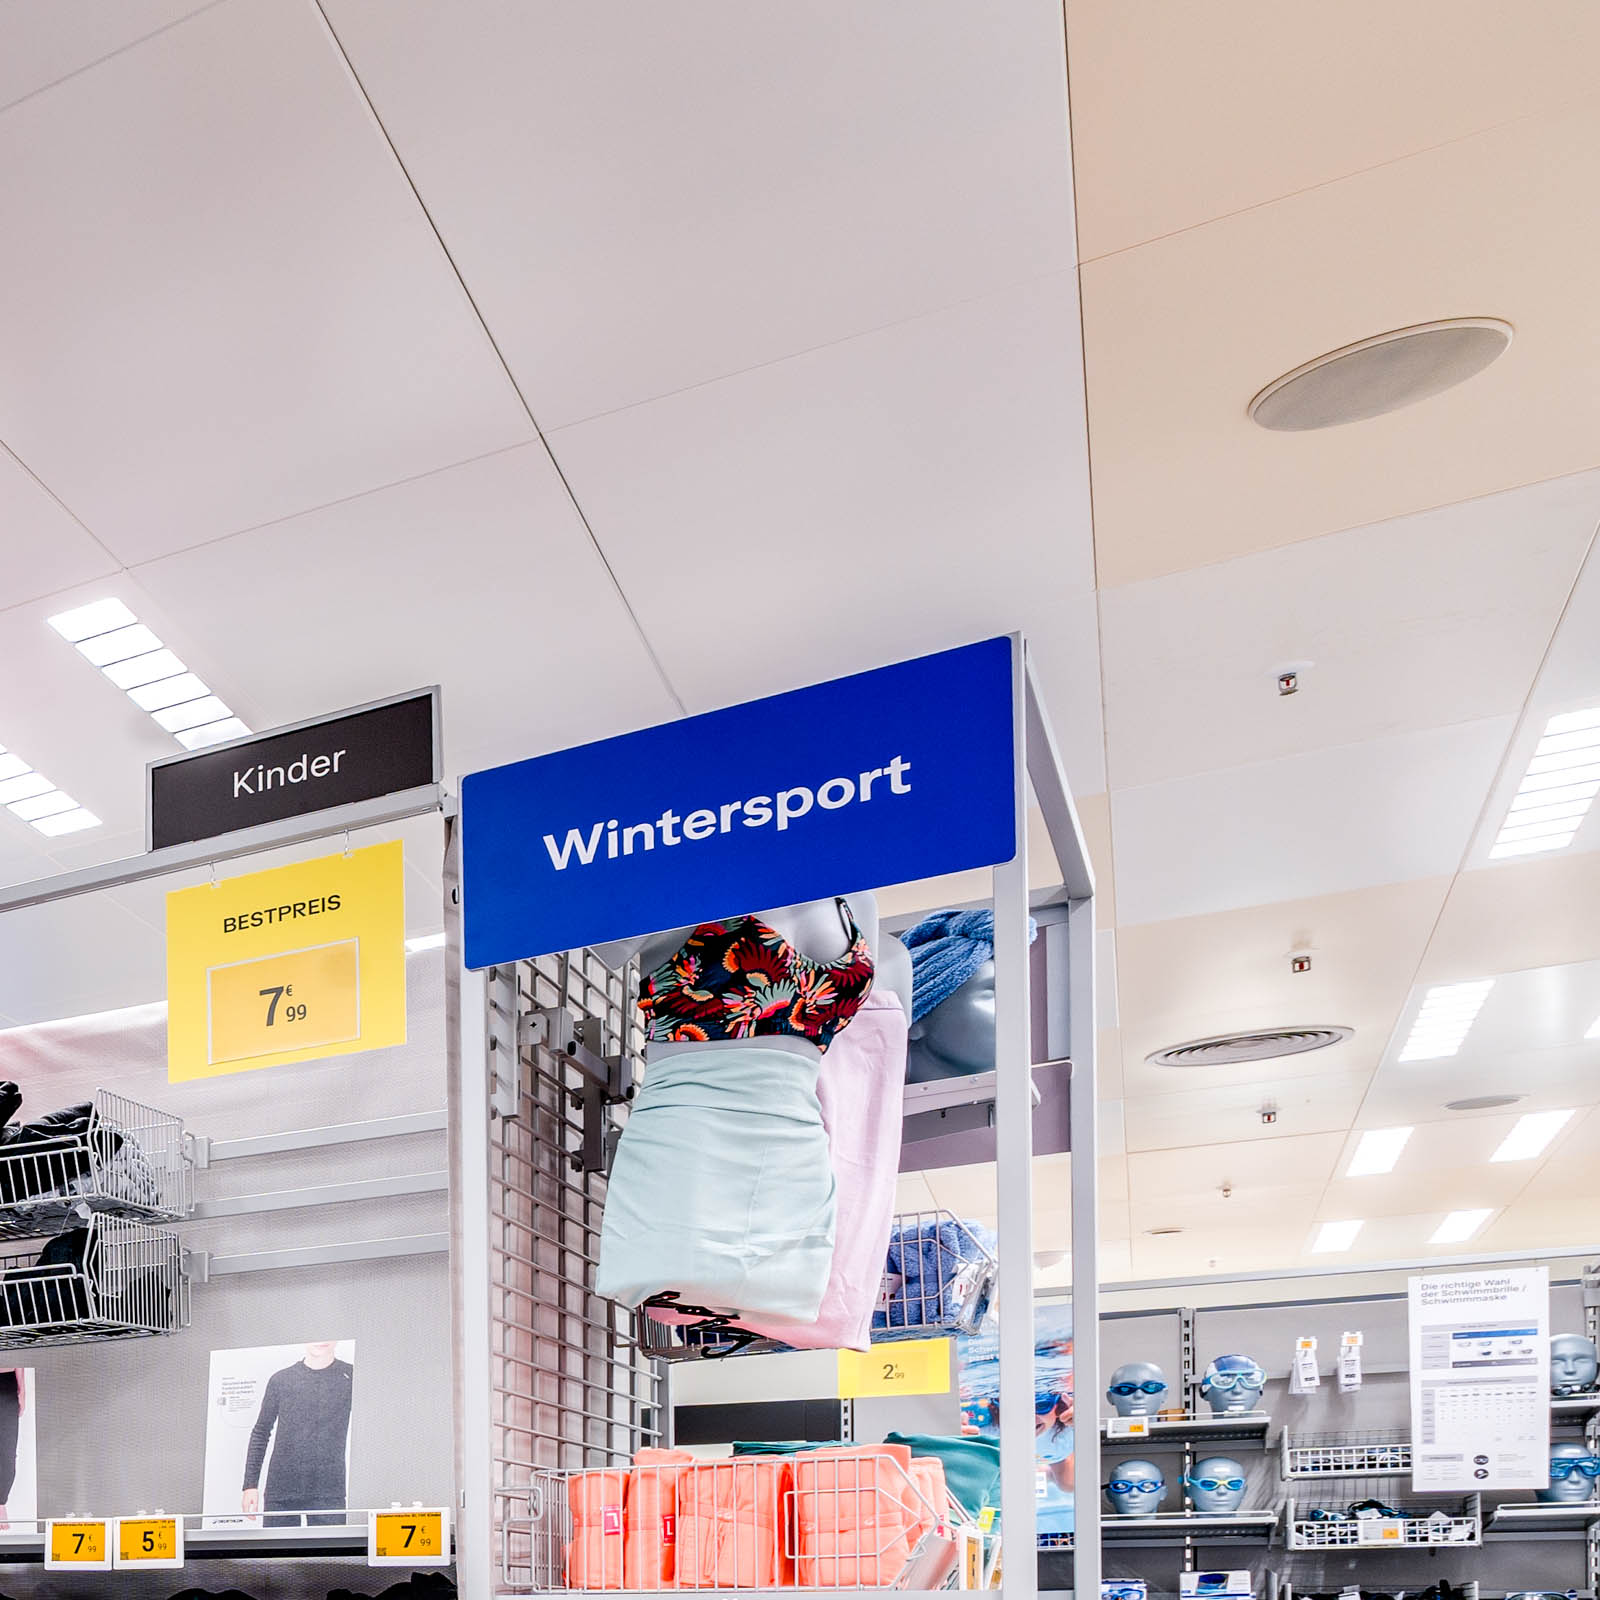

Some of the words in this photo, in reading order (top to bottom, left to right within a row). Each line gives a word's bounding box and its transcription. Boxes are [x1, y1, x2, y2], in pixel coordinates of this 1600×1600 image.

[232, 750, 346, 798] Kinder
[542, 755, 912, 871] Wintersport
[223, 894, 341, 933] BESTPREIS
[259, 986, 284, 1026] 7
[286, 1004, 307, 1022] 99
[1420, 1283, 1438, 1291] Die
[1441, 1280, 1482, 1290] richtige
[1484, 1278, 1511, 1286] Wahl
[1441, 1285, 1519, 1297] Schwimmbrille
[883, 1364, 894, 1380] 2
[72, 1533, 85, 1554] 7
[142, 1531, 154, 1552] 5
[401, 1525, 416, 1548] 7
[420, 1538, 431, 1546] 99
